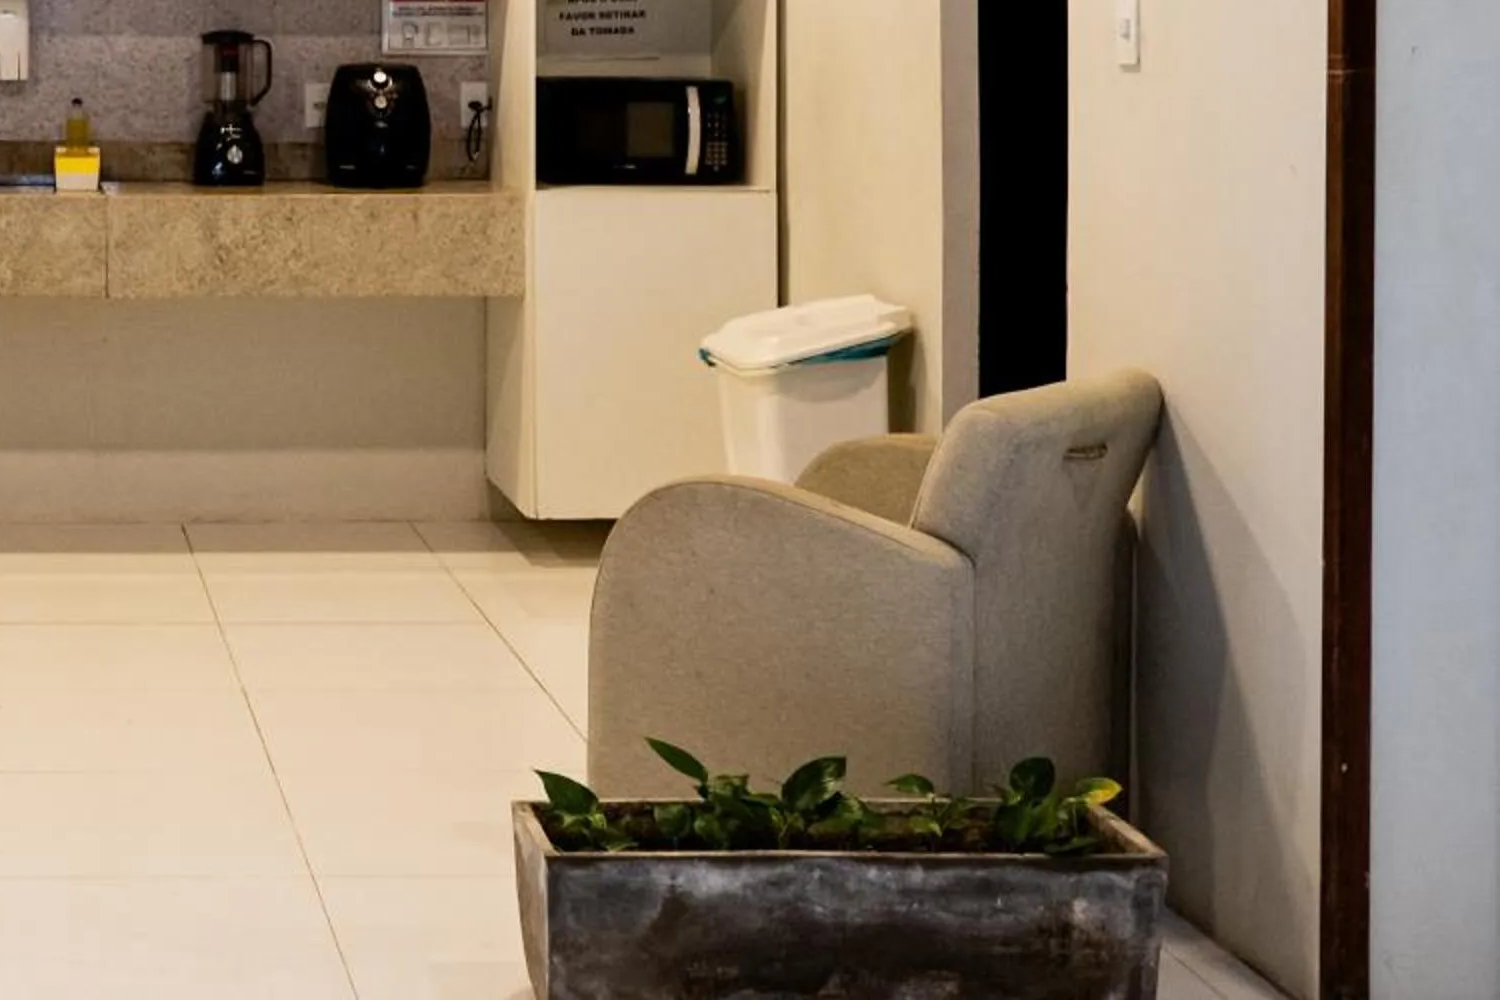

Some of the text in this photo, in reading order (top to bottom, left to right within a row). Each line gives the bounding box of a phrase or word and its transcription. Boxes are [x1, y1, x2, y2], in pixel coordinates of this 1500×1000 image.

[559, 10, 647, 20] FAVOR RETIRAR
[571, 26, 635, 36] DA TOMADA
